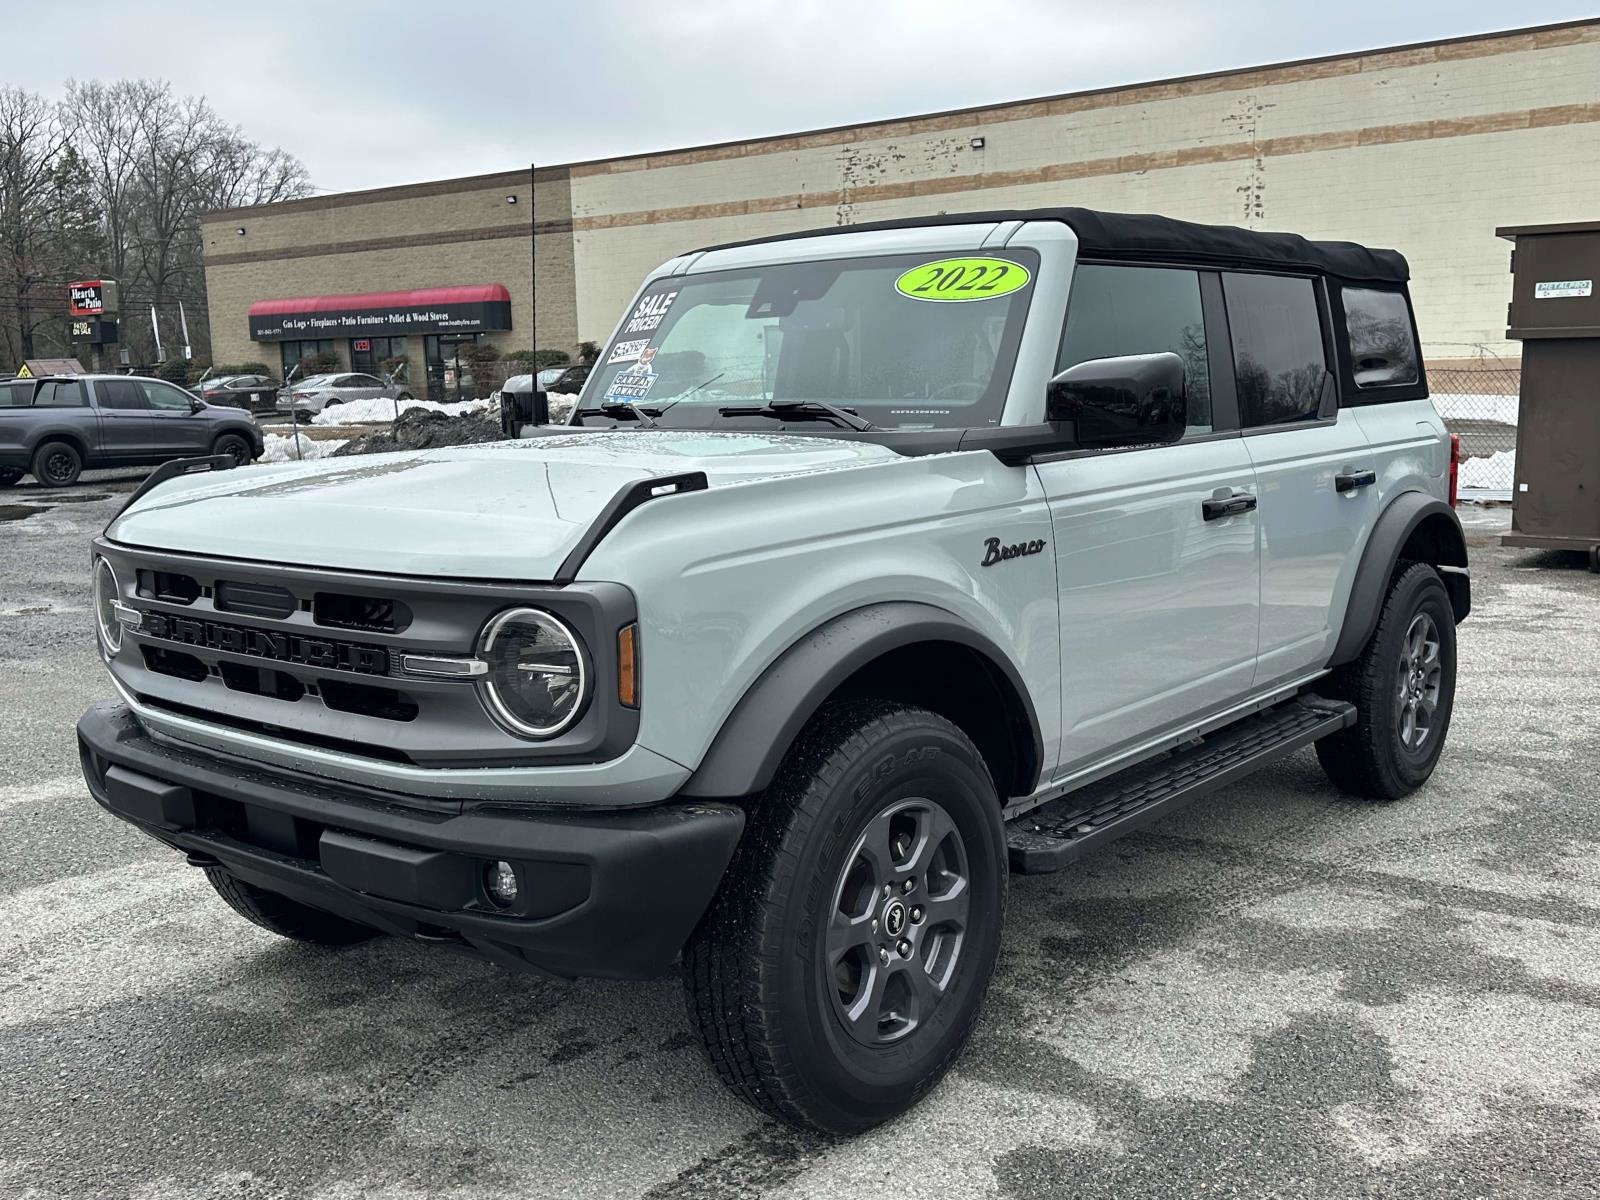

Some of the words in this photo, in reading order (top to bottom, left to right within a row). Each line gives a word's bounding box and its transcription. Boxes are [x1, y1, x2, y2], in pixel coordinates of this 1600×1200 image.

[912, 265, 1009, 292] 2022
[71, 287, 95, 299] Hearth
[85, 297, 102, 308] Patio
[634, 291, 678, 319] SALE
[282, 319, 293, 329] Gas
[294, 318, 307, 330] Logs
[310, 317, 338, 329] Fireplaces
[341, 316, 356, 326] Patio
[357, 314, 384, 325] Furniture
[388, 313, 404, 323] Pellet
[406, 313, 412, 322] &
[412, 311, 429, 322] Wood
[429, 311, 449, 321] Stoves
[624, 315, 664, 333] PRICED!
[615, 375, 654, 387] CARFAX
[615, 386, 647, 397] OWNER
[981, 536, 1047, 567] Bronco
[142, 609, 390, 674] BRONCO
